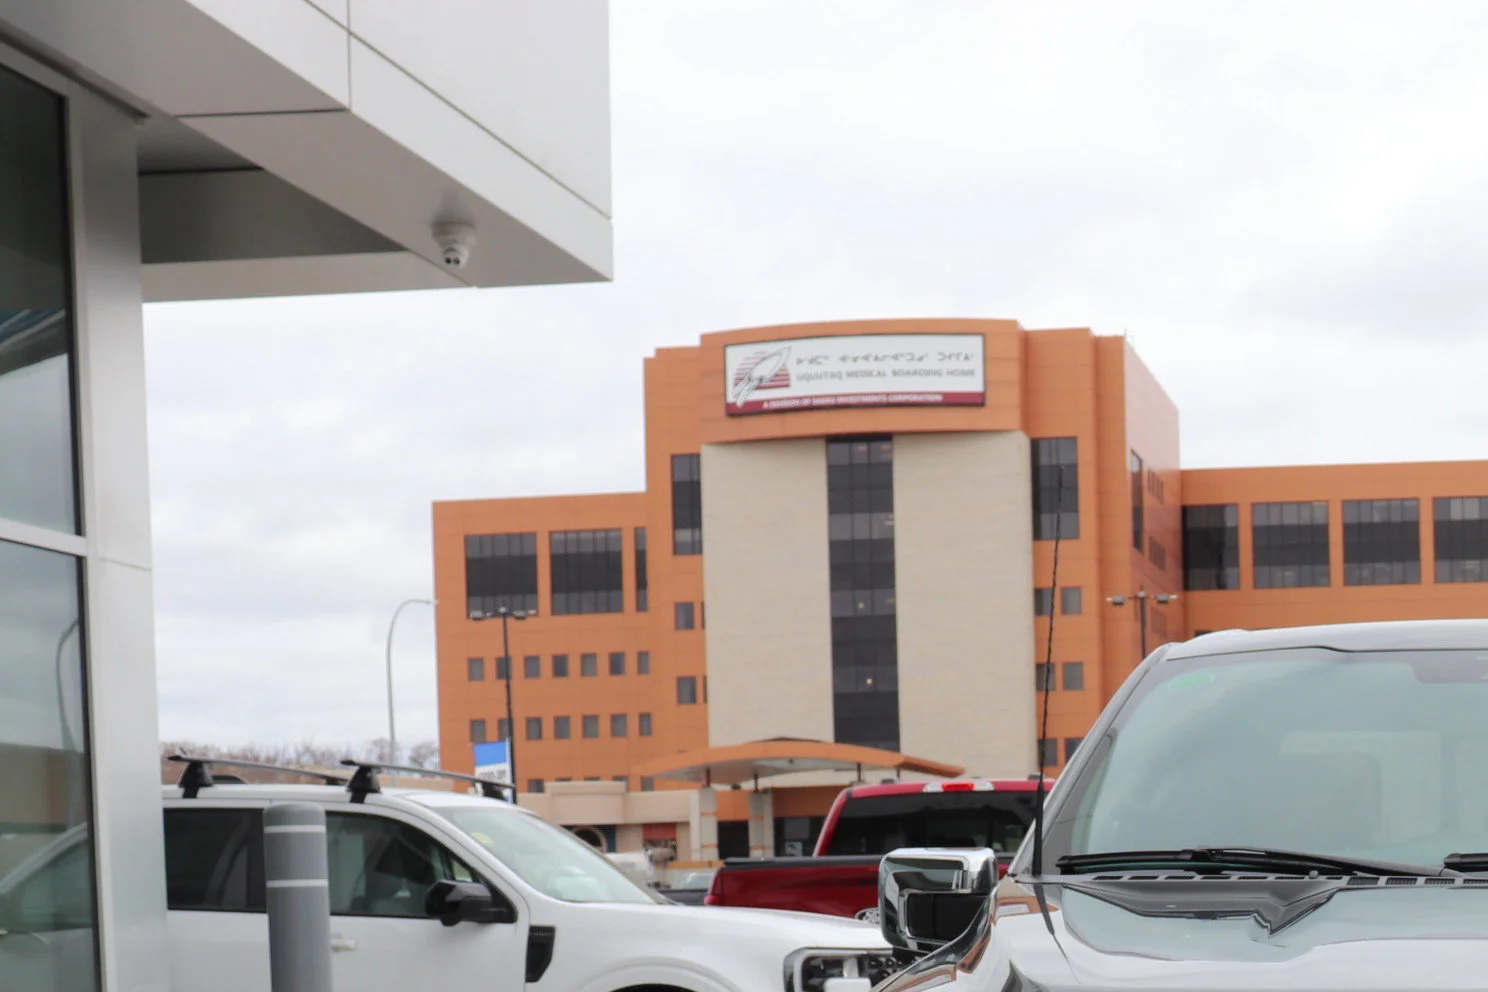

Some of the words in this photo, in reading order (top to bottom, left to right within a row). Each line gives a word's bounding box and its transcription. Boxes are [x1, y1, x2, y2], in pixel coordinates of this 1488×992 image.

[845, 368, 887, 379] MEDICAL
[891, 368, 943, 378] BOARDING
[946, 368, 976, 377] HOME
